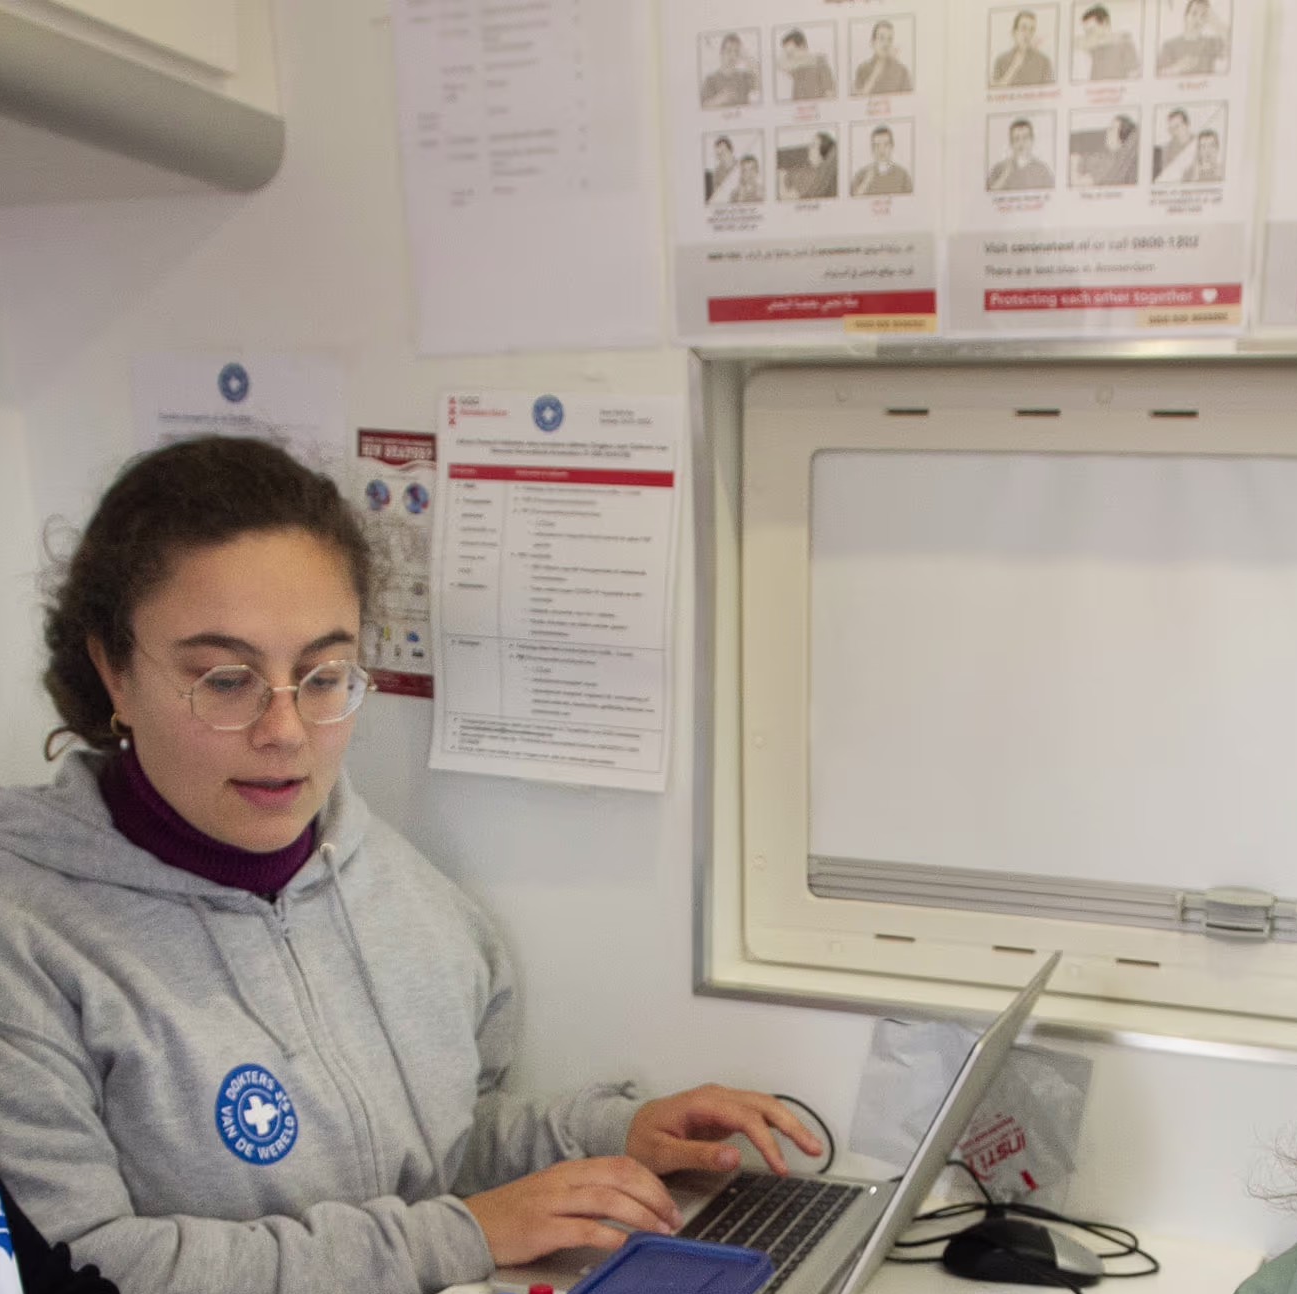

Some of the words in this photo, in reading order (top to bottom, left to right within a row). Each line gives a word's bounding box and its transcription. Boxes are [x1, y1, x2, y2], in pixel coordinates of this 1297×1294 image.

[989, 292, 1056, 308] Protecting
[1061, 290, 1091, 305] each
[1093, 290, 1129, 304] other
[1134, 288, 1192, 306] together
[225, 1070, 275, 1101] DOKTERS
[221, 1105, 238, 1139] VAN
[235, 1138, 255, 1158] DE
[257, 1116, 296, 1160] WERELD
